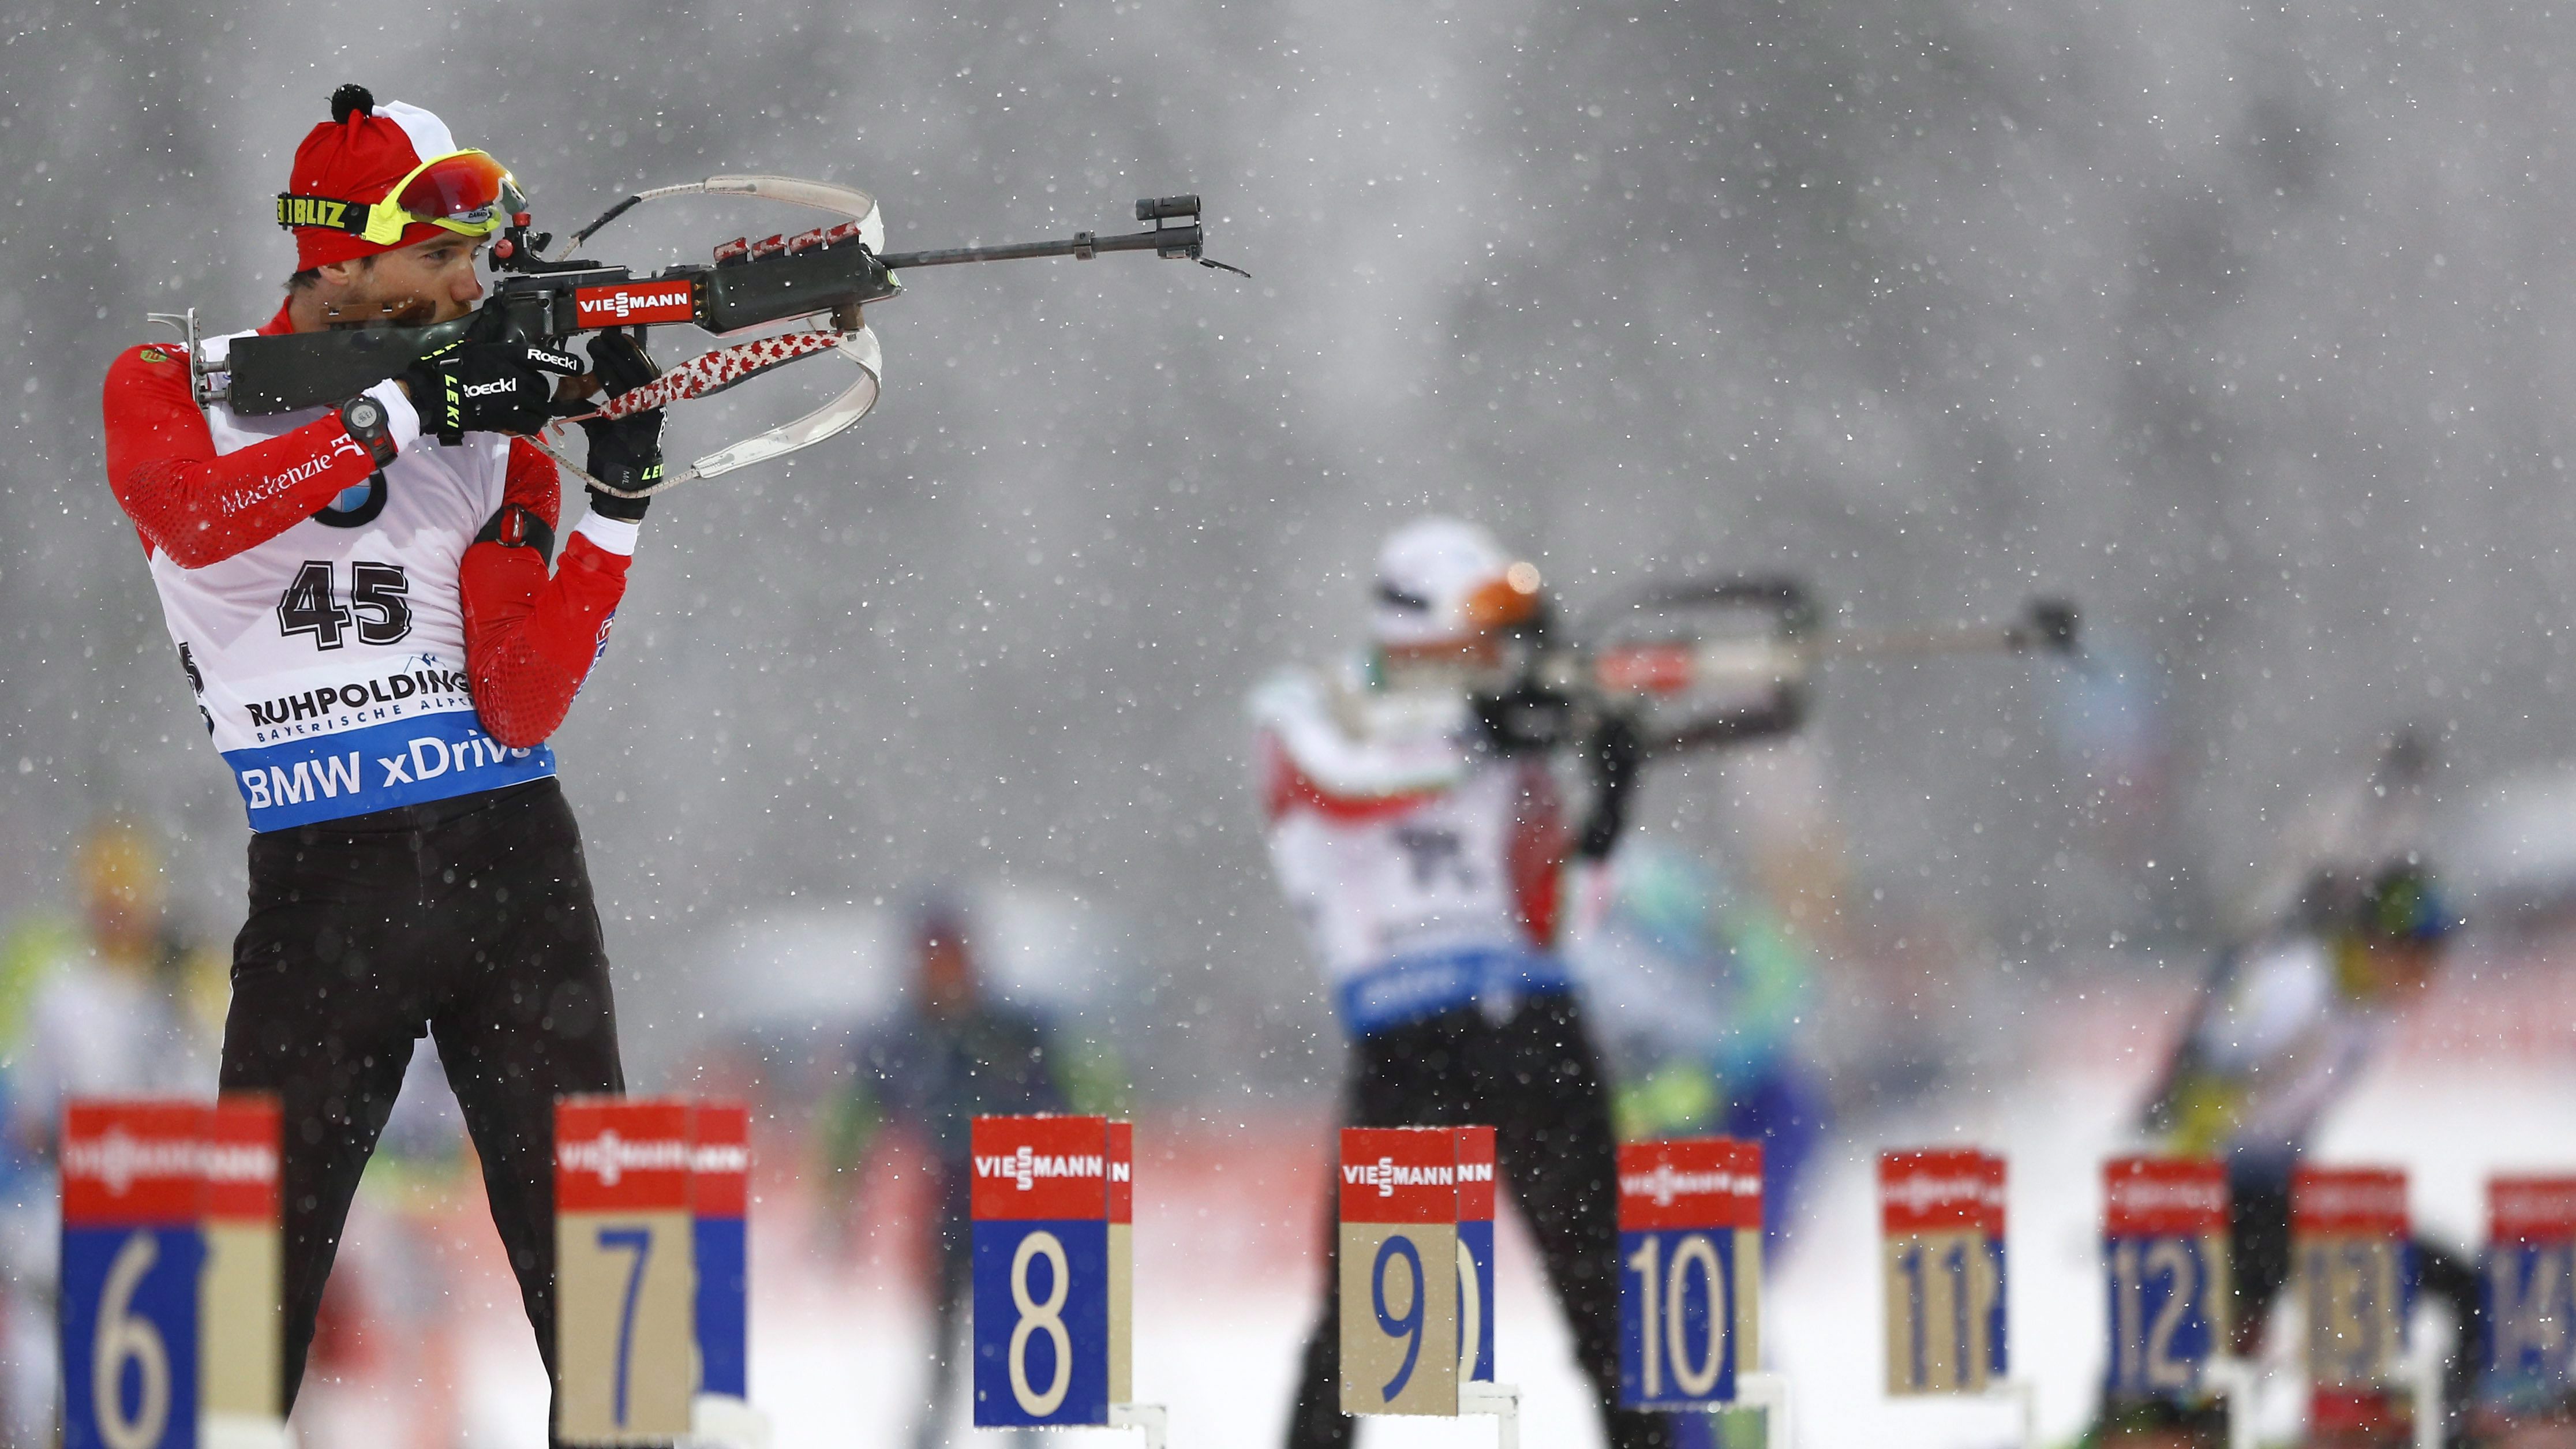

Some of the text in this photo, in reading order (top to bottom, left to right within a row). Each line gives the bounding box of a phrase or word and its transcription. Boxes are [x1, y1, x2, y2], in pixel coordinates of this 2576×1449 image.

[294, 199, 347, 229] BLIZ
[579, 291, 687, 317] VIESSMANN
[445, 374, 460, 428] LEKI
[277, 560, 412, 651] 45
[245, 669, 469, 727] RUHPOLDING
[256, 705, 401, 743] BAYERISCHE
[241, 752, 360, 809] BMW
[975, 1145, 1103, 1190] VIESSMANN
[1342, 1156, 1454, 1197] VIESSMANN
[91, 1229, 170, 1449] 6
[597, 1225, 653, 1429] 7
[1009, 1231, 1072, 1417] 8
[1372, 1235, 1424, 1403] 9
[1628, 1234, 1725, 1398] 10
[1897, 1244, 1972, 1388] 11
[2113, 1242, 2192, 1383] 12
